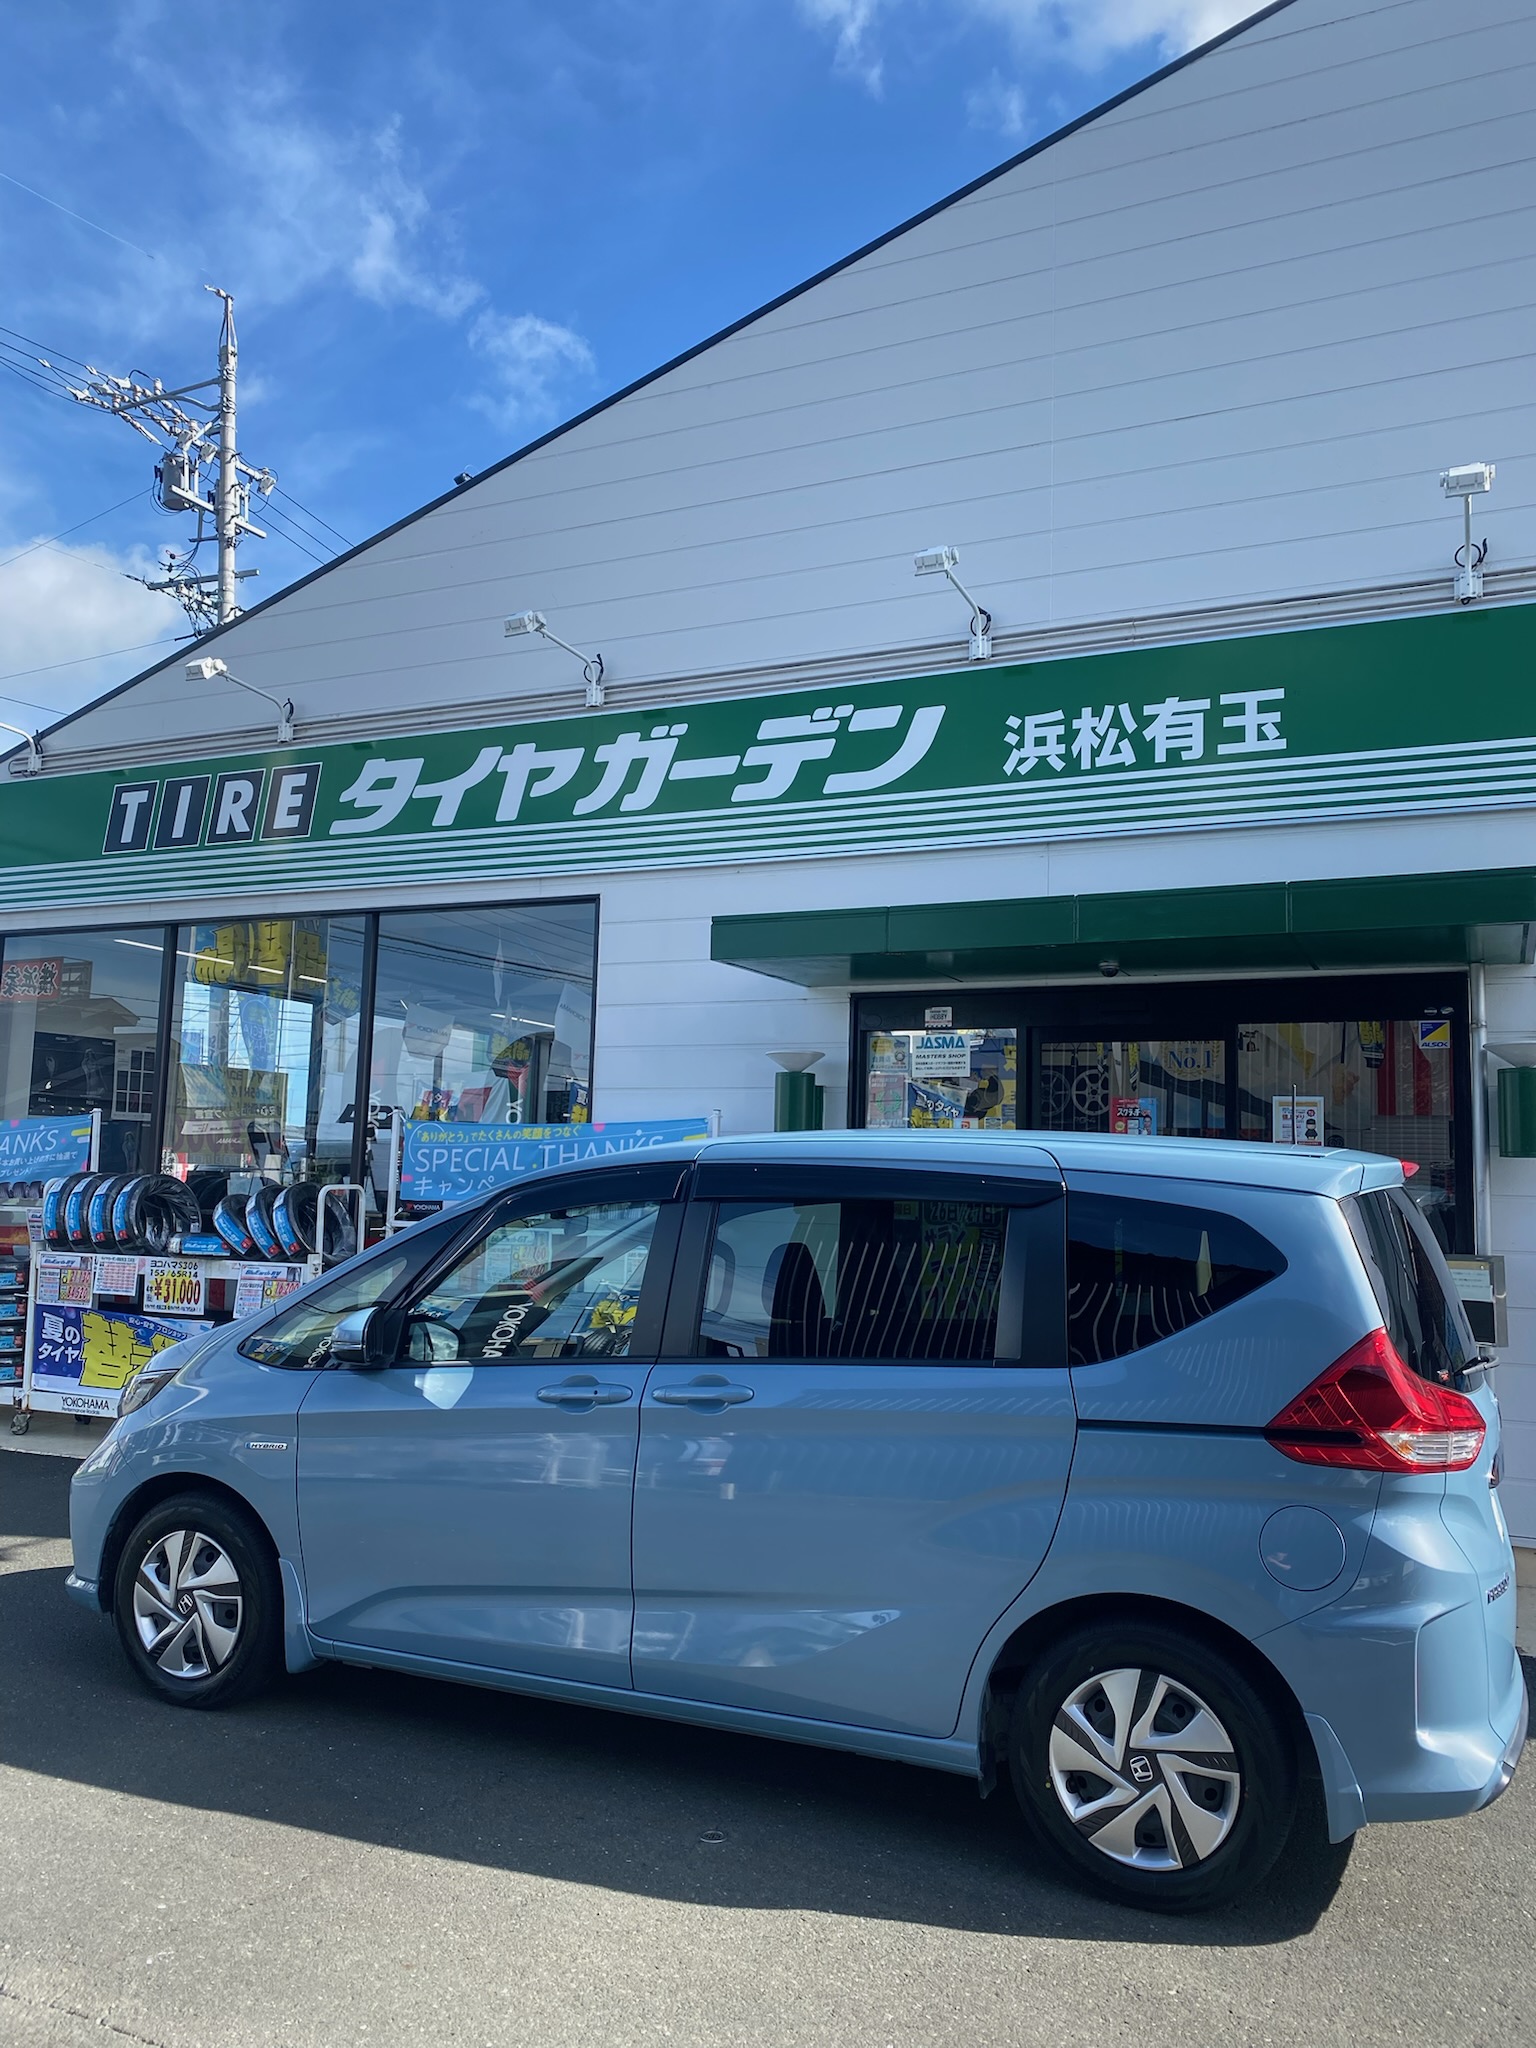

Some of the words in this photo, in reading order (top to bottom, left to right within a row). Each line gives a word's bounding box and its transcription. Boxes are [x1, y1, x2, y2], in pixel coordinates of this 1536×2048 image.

[118, 772, 308, 844] TIRE
[329, 704, 946, 835] タイヤガーデン
[1003, 688, 1287, 776] 浜松有玉
[916, 1036, 966, 1049] JASMA
[1168, 1049, 1213, 1070] No.1
[415, 1146, 526, 1173] SPECIAL
[154, 1278, 201, 1305] ¥31,000
[42, 1312, 80, 1344] 夏の
[38, 1342, 80, 1364] タイヤ
[61, 1396, 110, 1410] YOKOHAMA
[250, 1442, 284, 1450] HYBRID
